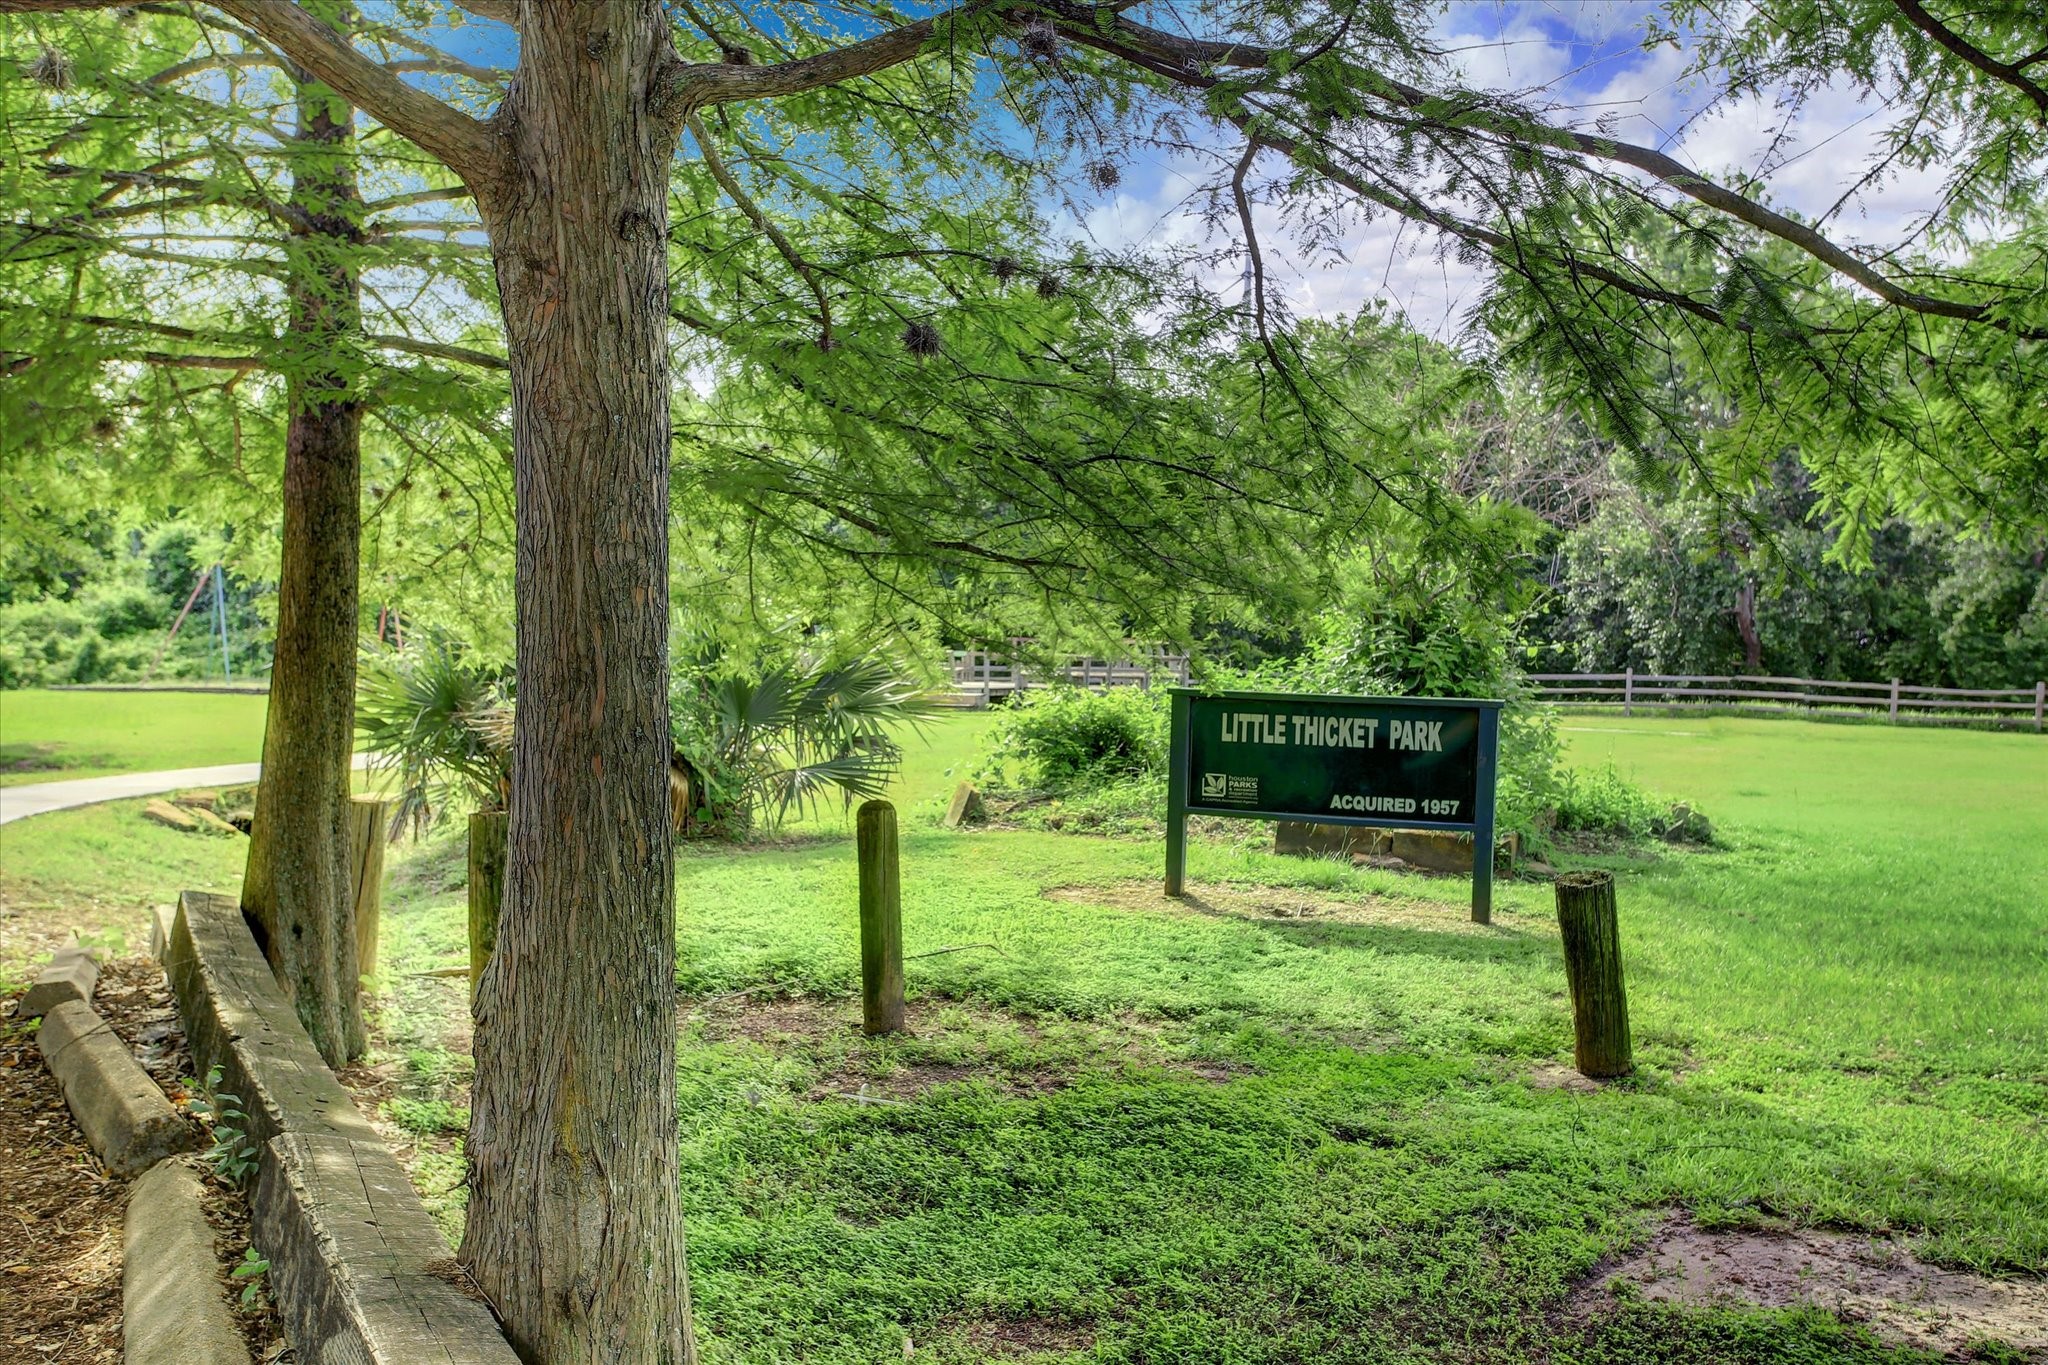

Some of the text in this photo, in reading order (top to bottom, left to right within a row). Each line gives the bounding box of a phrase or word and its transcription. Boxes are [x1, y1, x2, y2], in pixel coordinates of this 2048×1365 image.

[1221, 712, 1443, 752] LITTLE THICKET PARK
[1329, 795, 1460, 816] ACQUIRED 1957
